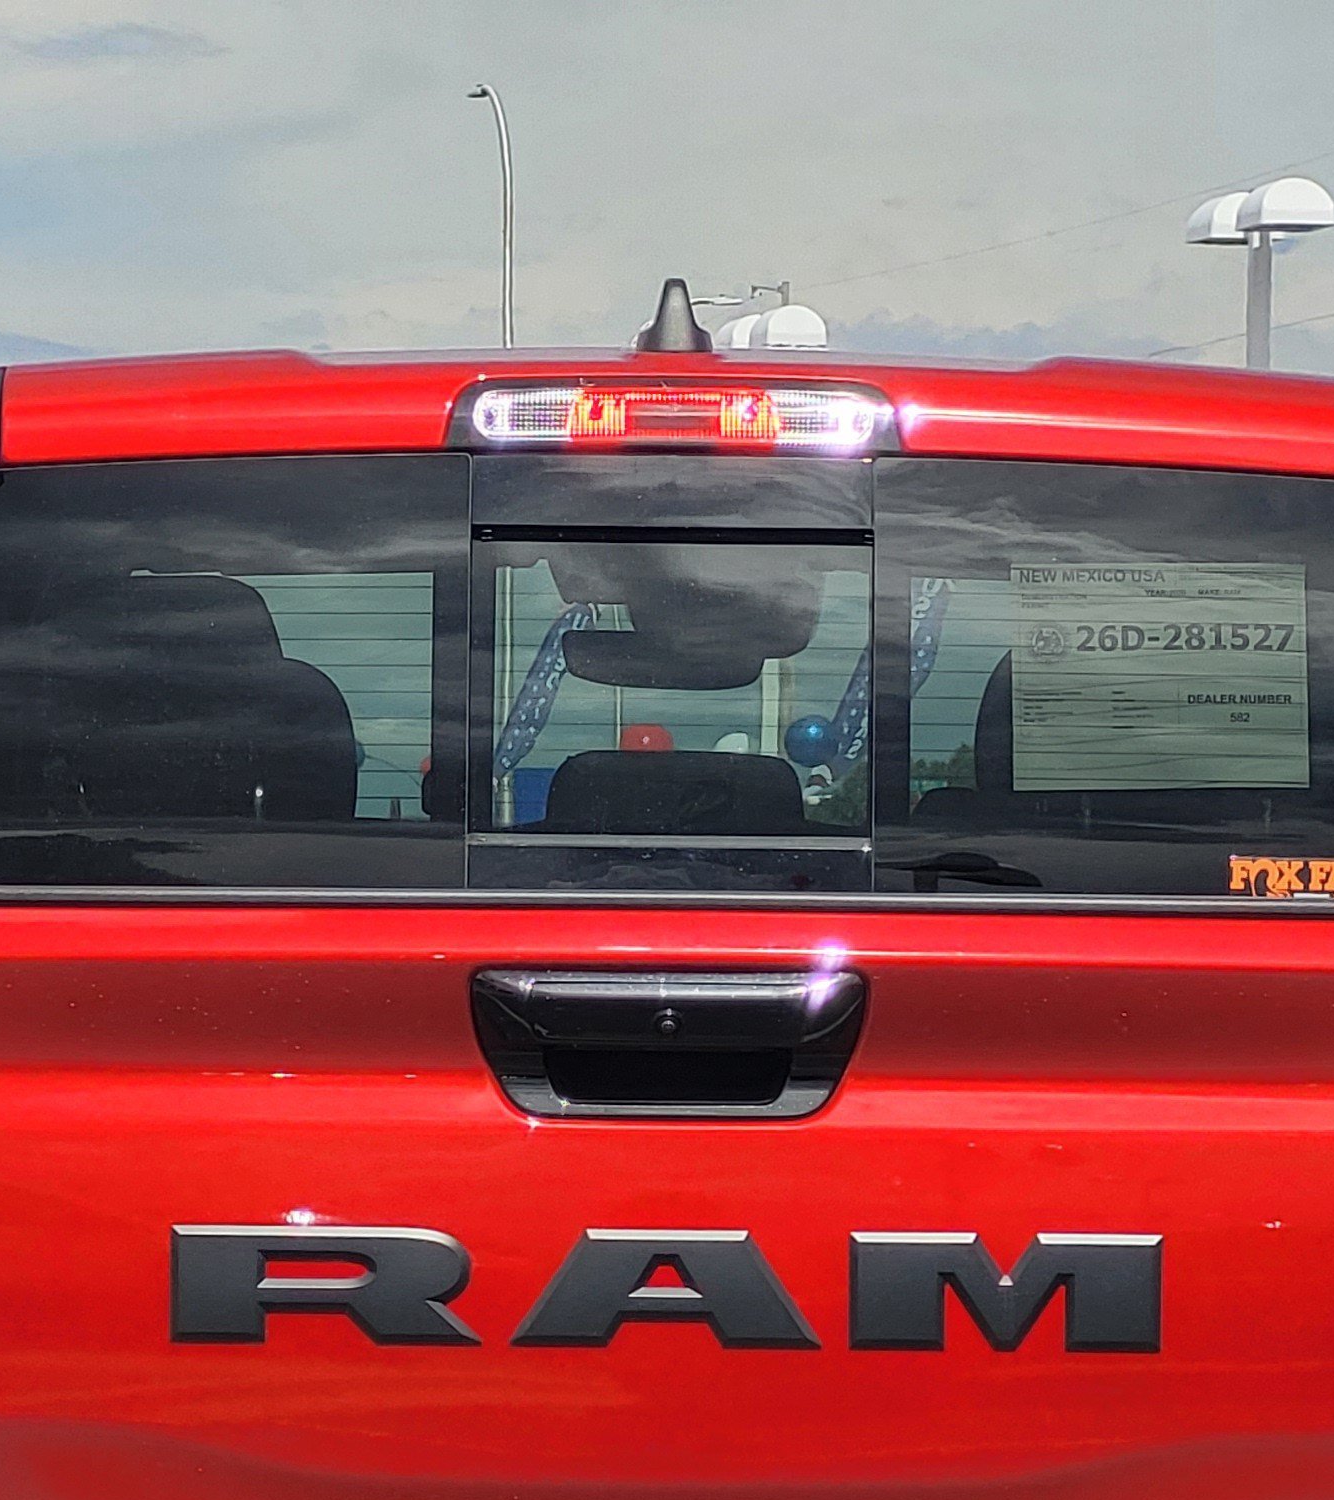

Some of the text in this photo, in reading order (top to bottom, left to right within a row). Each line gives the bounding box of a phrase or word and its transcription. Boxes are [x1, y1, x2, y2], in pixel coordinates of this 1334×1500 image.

[1019, 569, 1165, 583] NEW MEXICO USA
[1076, 623, 1295, 651] 26D-281527
[1187, 694, 1292, 705] DEALER NUMBER
[1230, 712, 1250, 723] 582
[1229, 858, 1304, 896] FOX
[169, 1223, 1163, 1353] RAM
